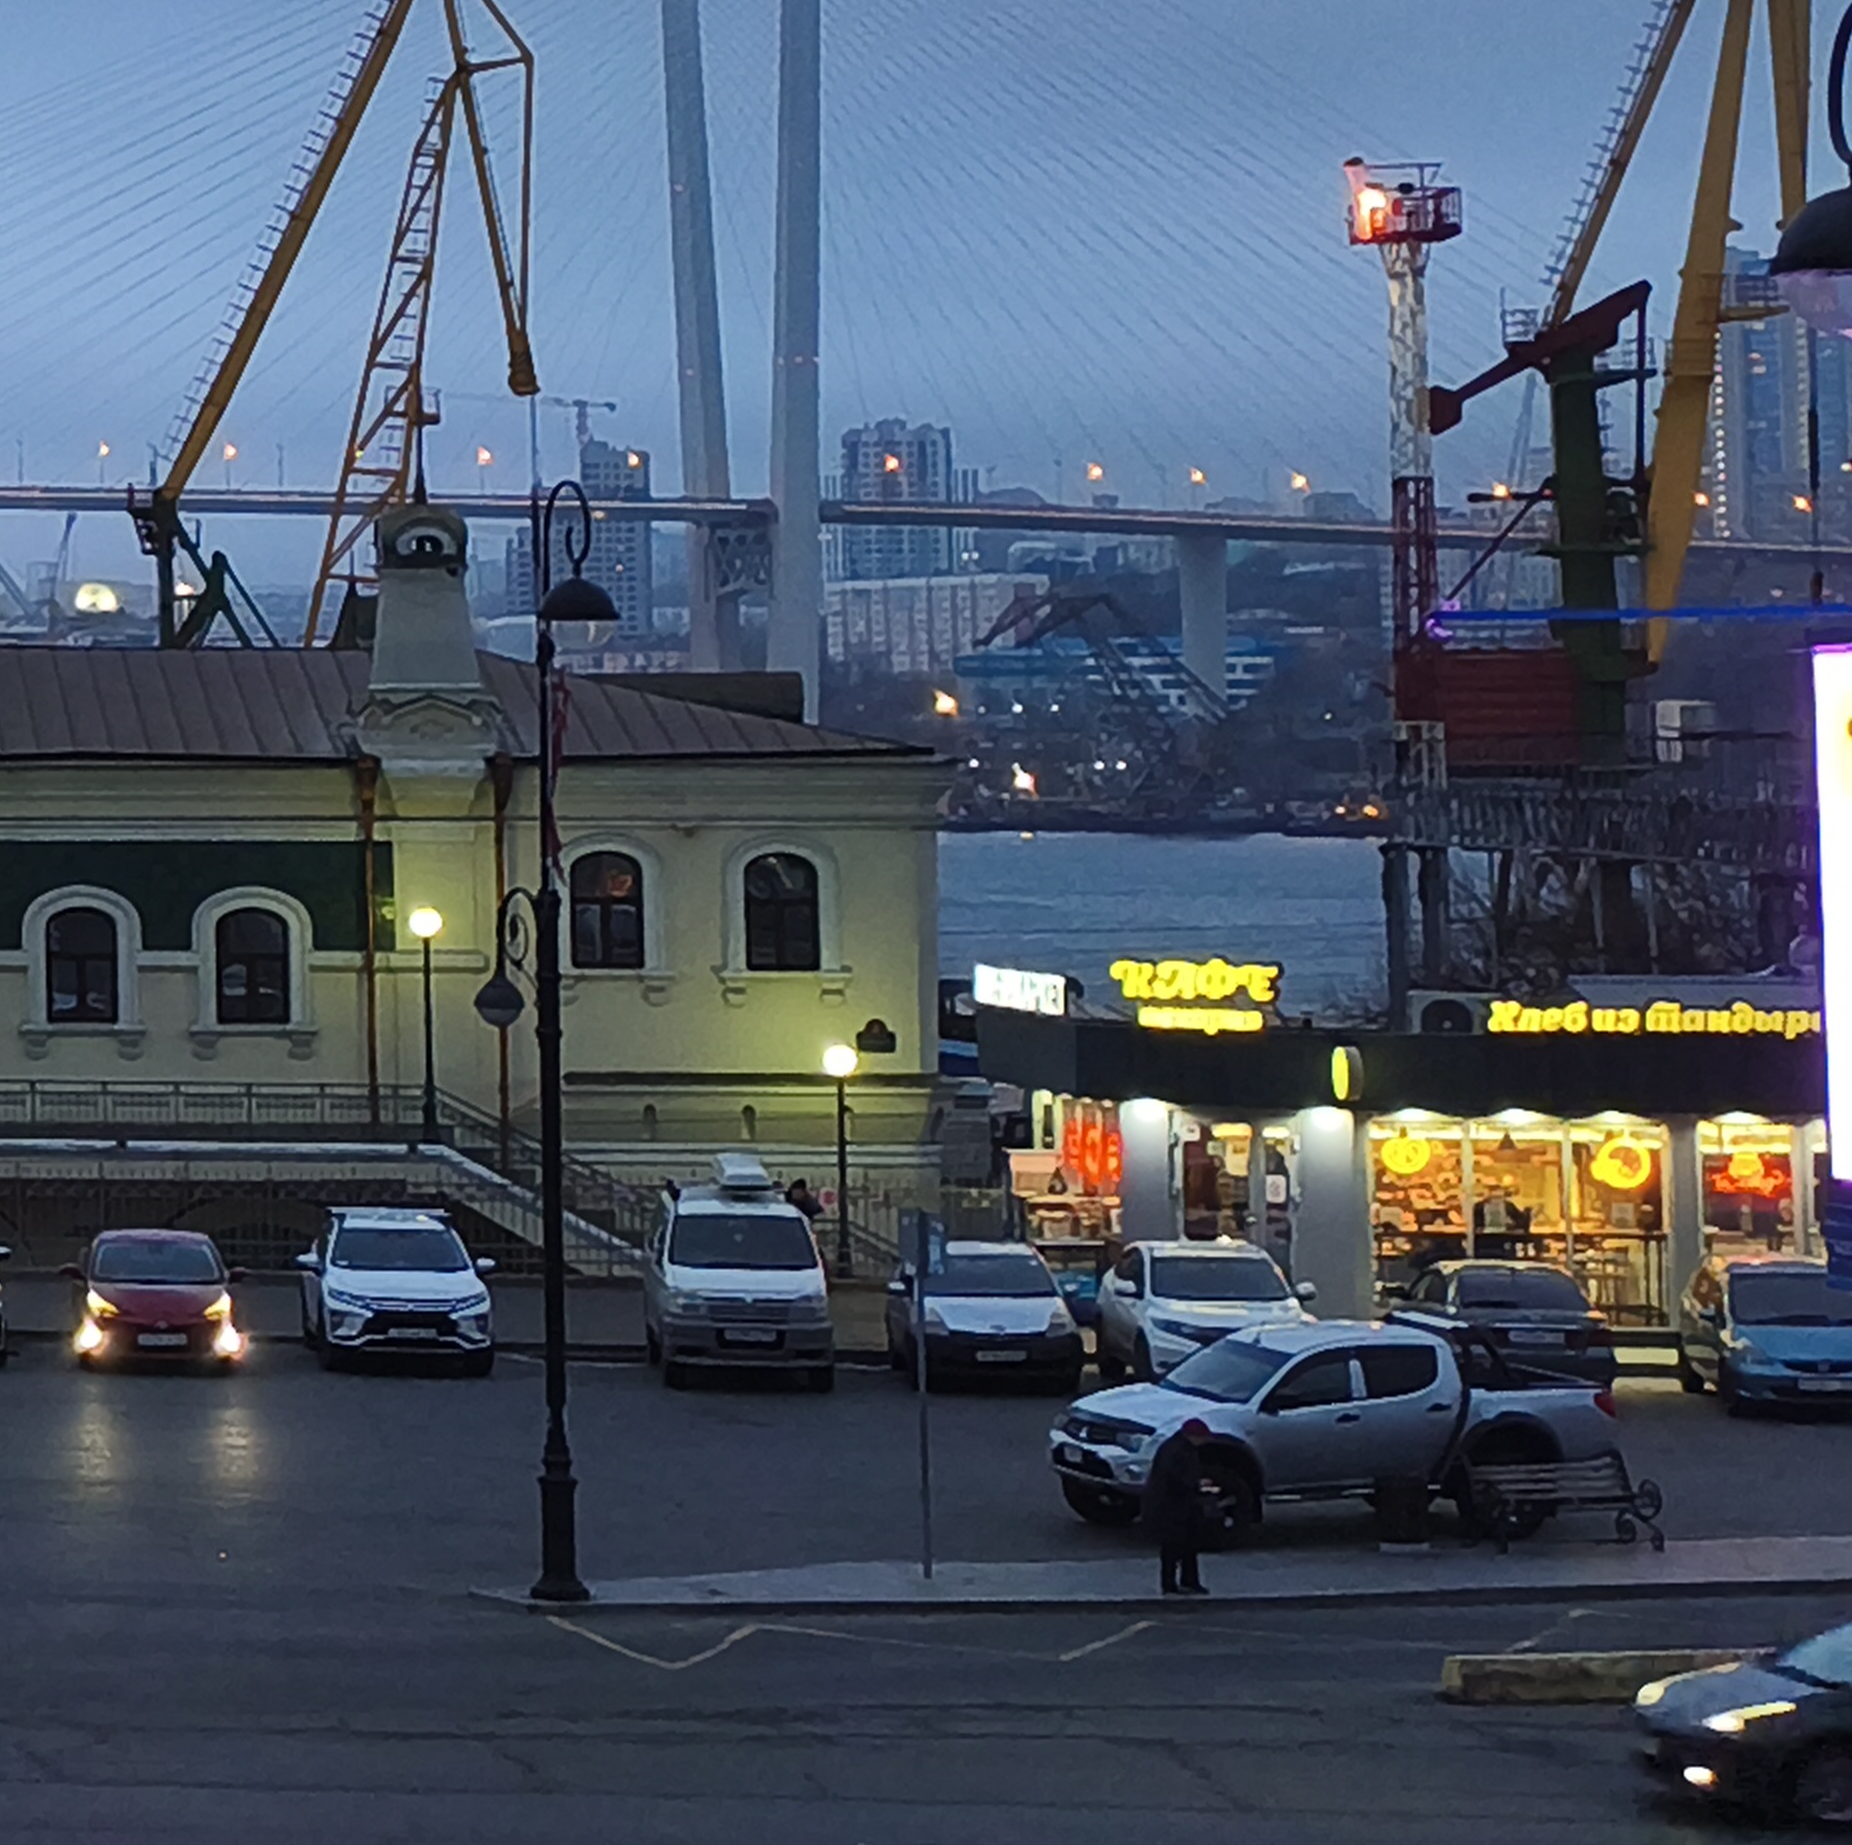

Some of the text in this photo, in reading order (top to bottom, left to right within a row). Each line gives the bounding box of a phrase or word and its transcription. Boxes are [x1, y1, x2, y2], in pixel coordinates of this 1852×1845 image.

[1110, 958, 1279, 1002] КАФЕ
[1487, 1000, 1588, 1032] Хлеб
[1592, 1008, 1640, 1033] из
